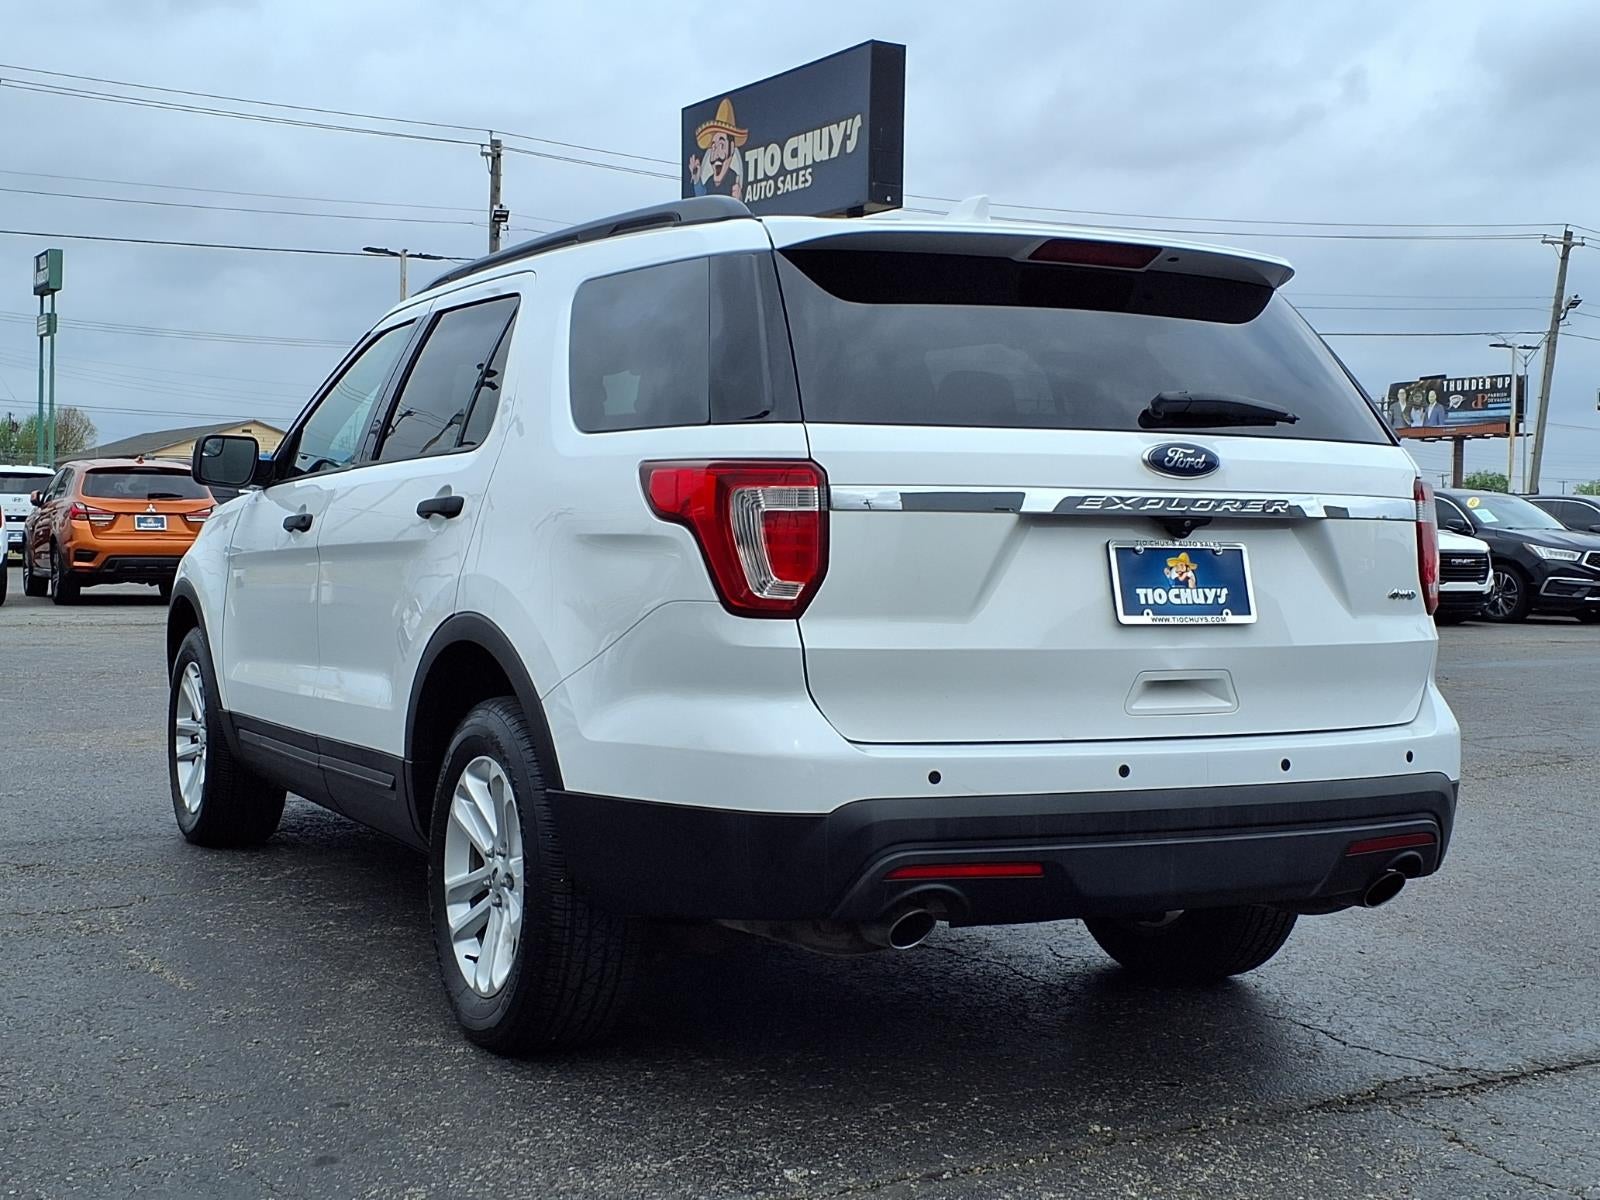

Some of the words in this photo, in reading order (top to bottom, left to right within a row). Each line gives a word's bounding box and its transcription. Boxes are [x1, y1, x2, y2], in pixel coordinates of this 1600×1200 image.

[745, 143, 781, 182] TIO
[783, 114, 862, 171] CHUY'S
[745, 183, 774, 203] AUTO
[777, 168, 813, 195] SALES
[1442, 378, 1491, 392] THUNDER
[1497, 377, 1511, 388] UP
[1163, 447, 1206, 469] Ford
[1075, 495, 1290, 513] EXPLORER
[1136, 588, 1168, 605] TIO
[1168, 587, 1229, 605] CHUY'S
